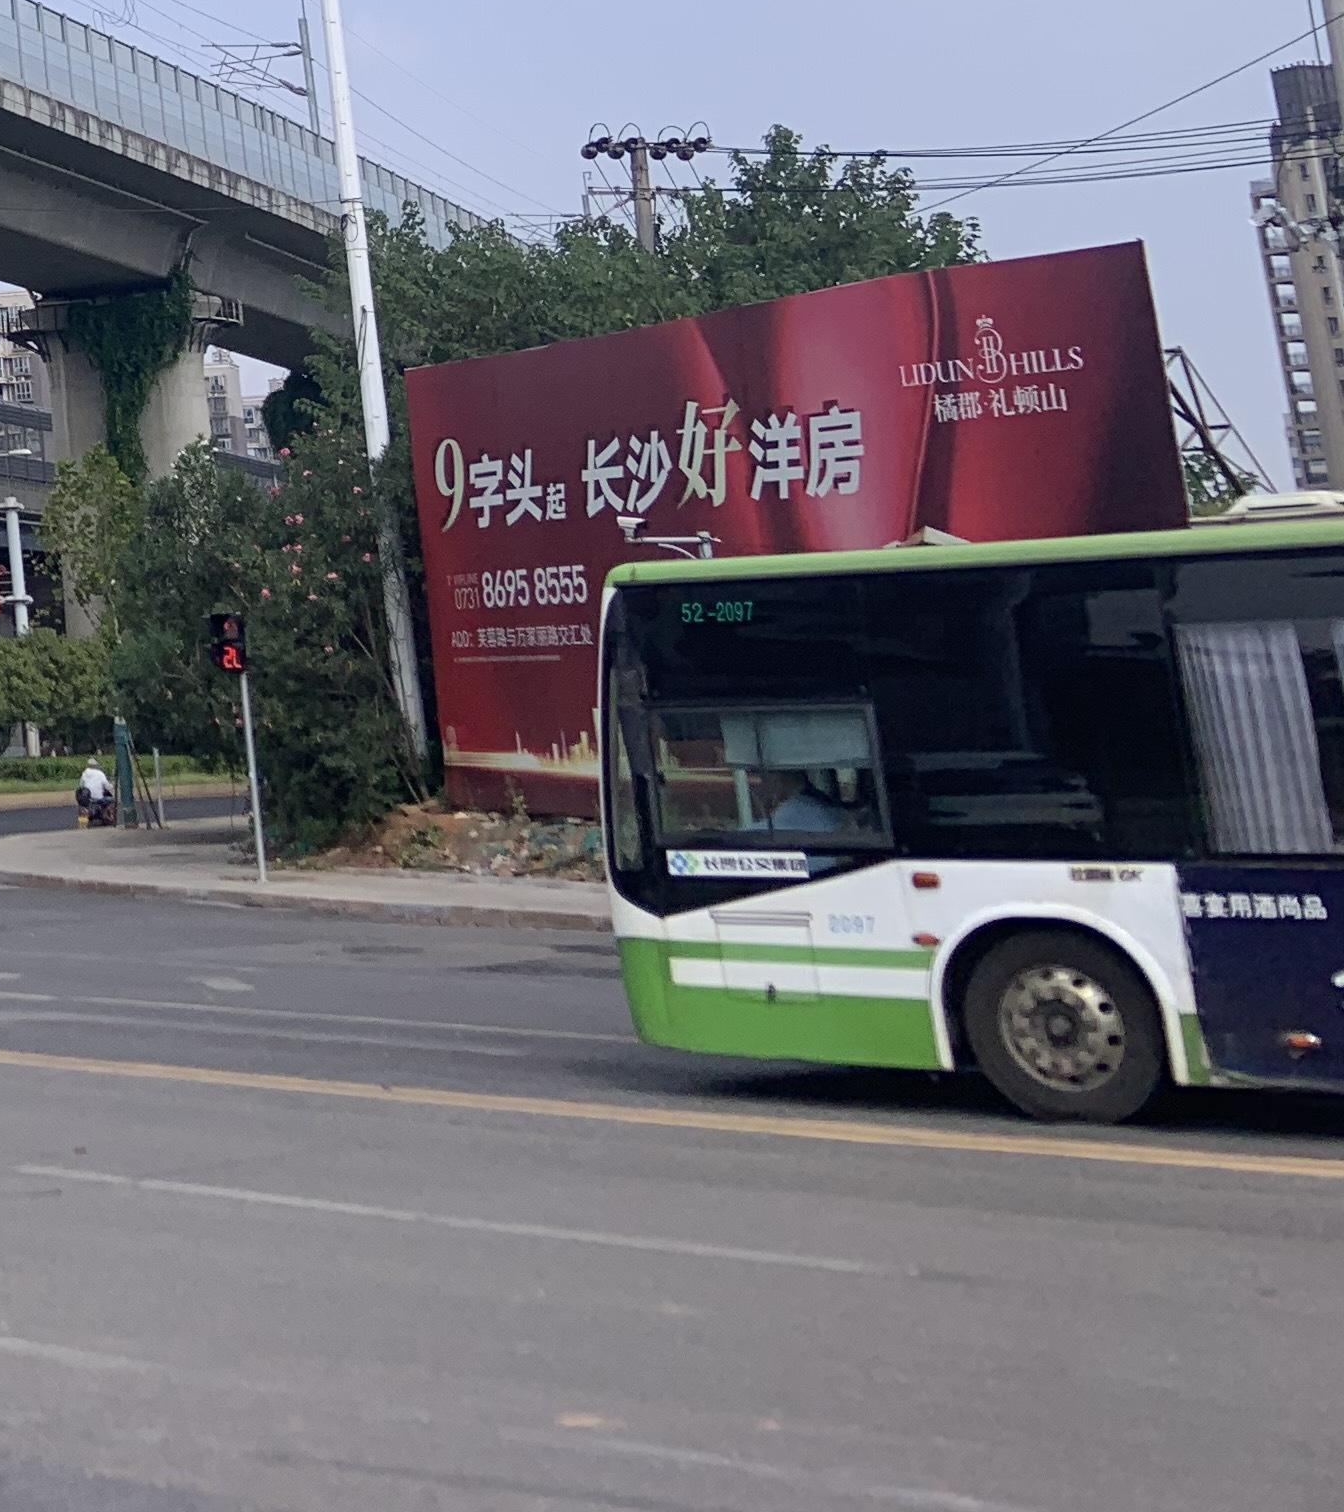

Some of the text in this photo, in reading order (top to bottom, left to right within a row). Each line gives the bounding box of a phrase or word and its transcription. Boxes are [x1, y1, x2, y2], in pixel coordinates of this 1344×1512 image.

[899, 345, 1085, 387] LIDUN HILLS
[433, 397, 865, 533] 9字头起 长沙好洋房
[454, 564, 588, 610] 0731 8695 8555
[681, 601, 754, 623] 52-2097
